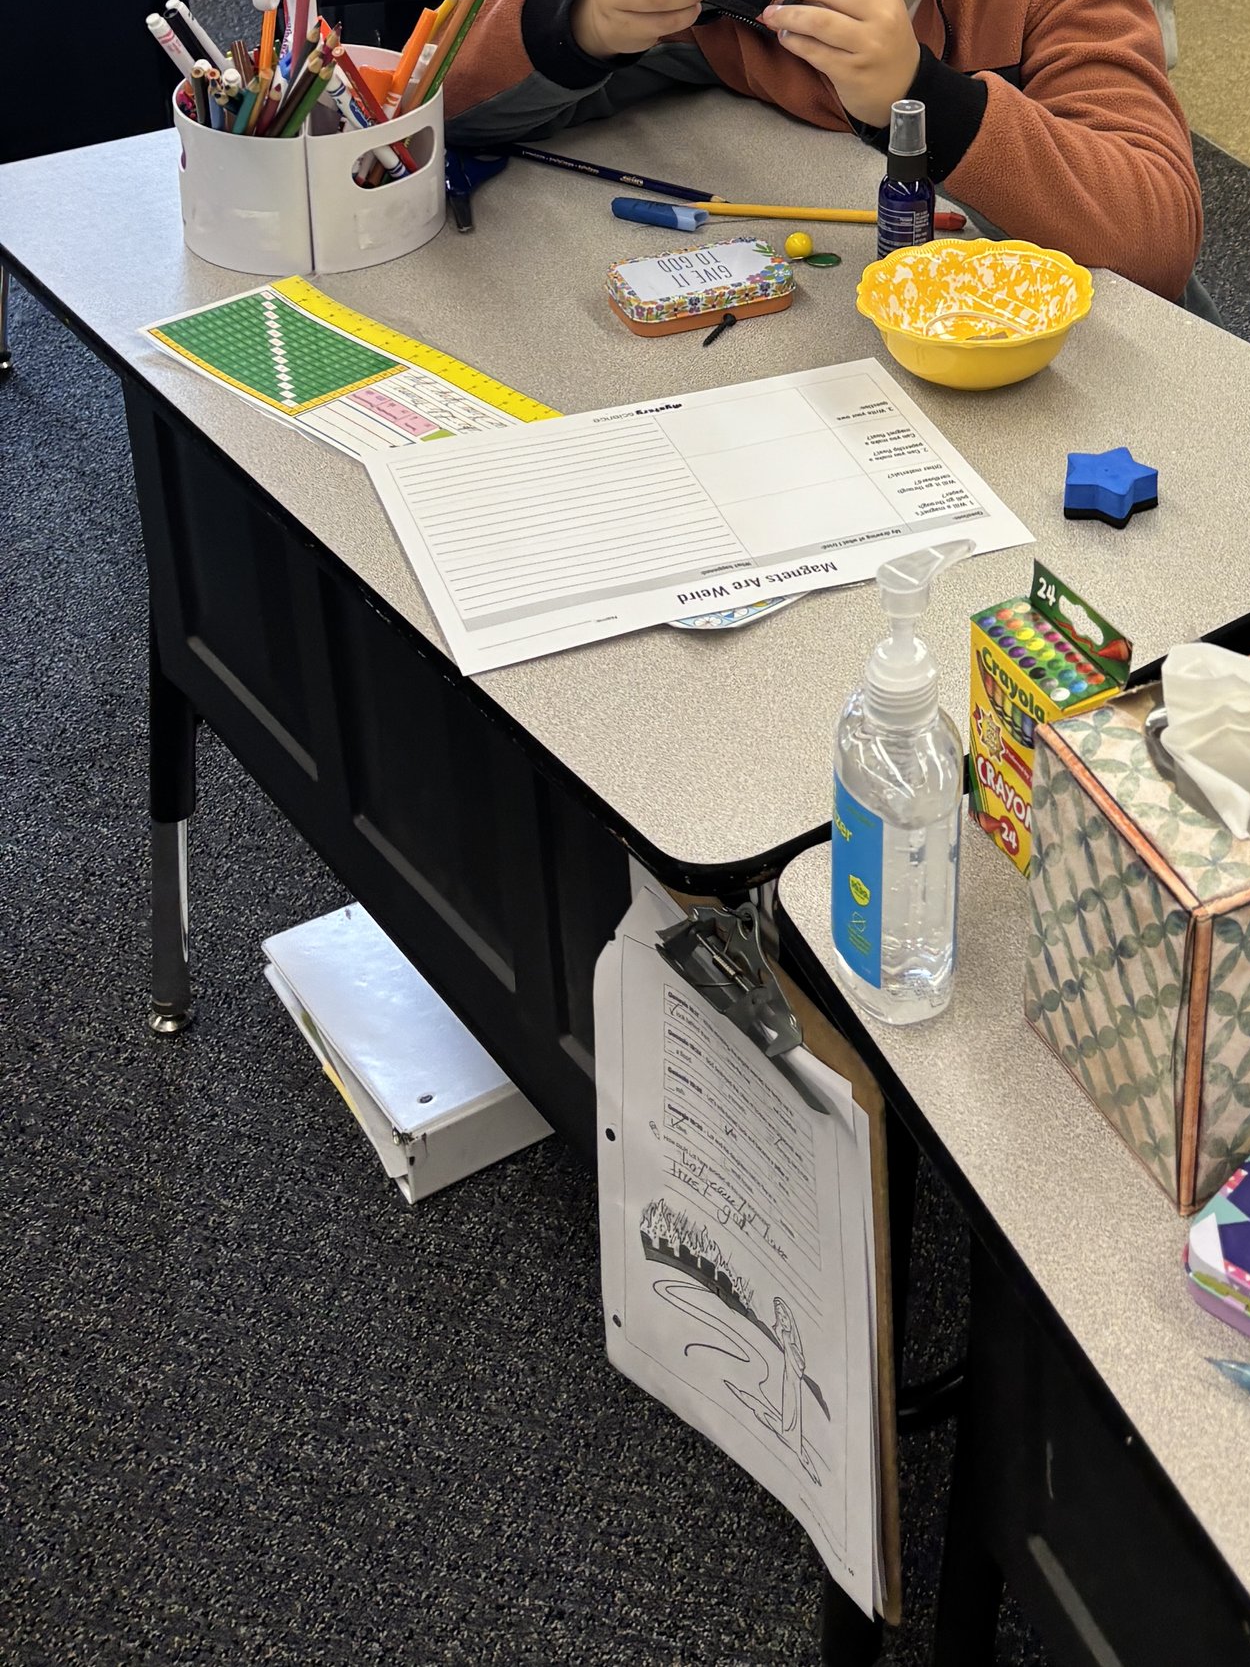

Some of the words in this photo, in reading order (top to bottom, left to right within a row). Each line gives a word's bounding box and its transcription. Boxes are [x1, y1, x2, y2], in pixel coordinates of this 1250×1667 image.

[657, 255, 694, 273] GOD
[697, 250, 721, 265] TO
[671, 274, 690, 288] IT
[699, 264, 733, 284] GIVE
[592, 411, 634, 424] science
[635, 403, 682, 417] mystery
[888, 468, 922, 479] materials?
[897, 485, 924, 494] through
[918, 500, 945, 509] through
[867, 530, 891, 539] drawing
[768, 561, 838, 584] Magnets
[733, 577, 762, 591] Are
[1036, 576, 1057, 606] 24
[677, 585, 731, 606] Weird
[981, 646, 1045, 724] Crayola
[976, 755, 1032, 832] CRAYON
[1000, 822, 1018, 849] 24
